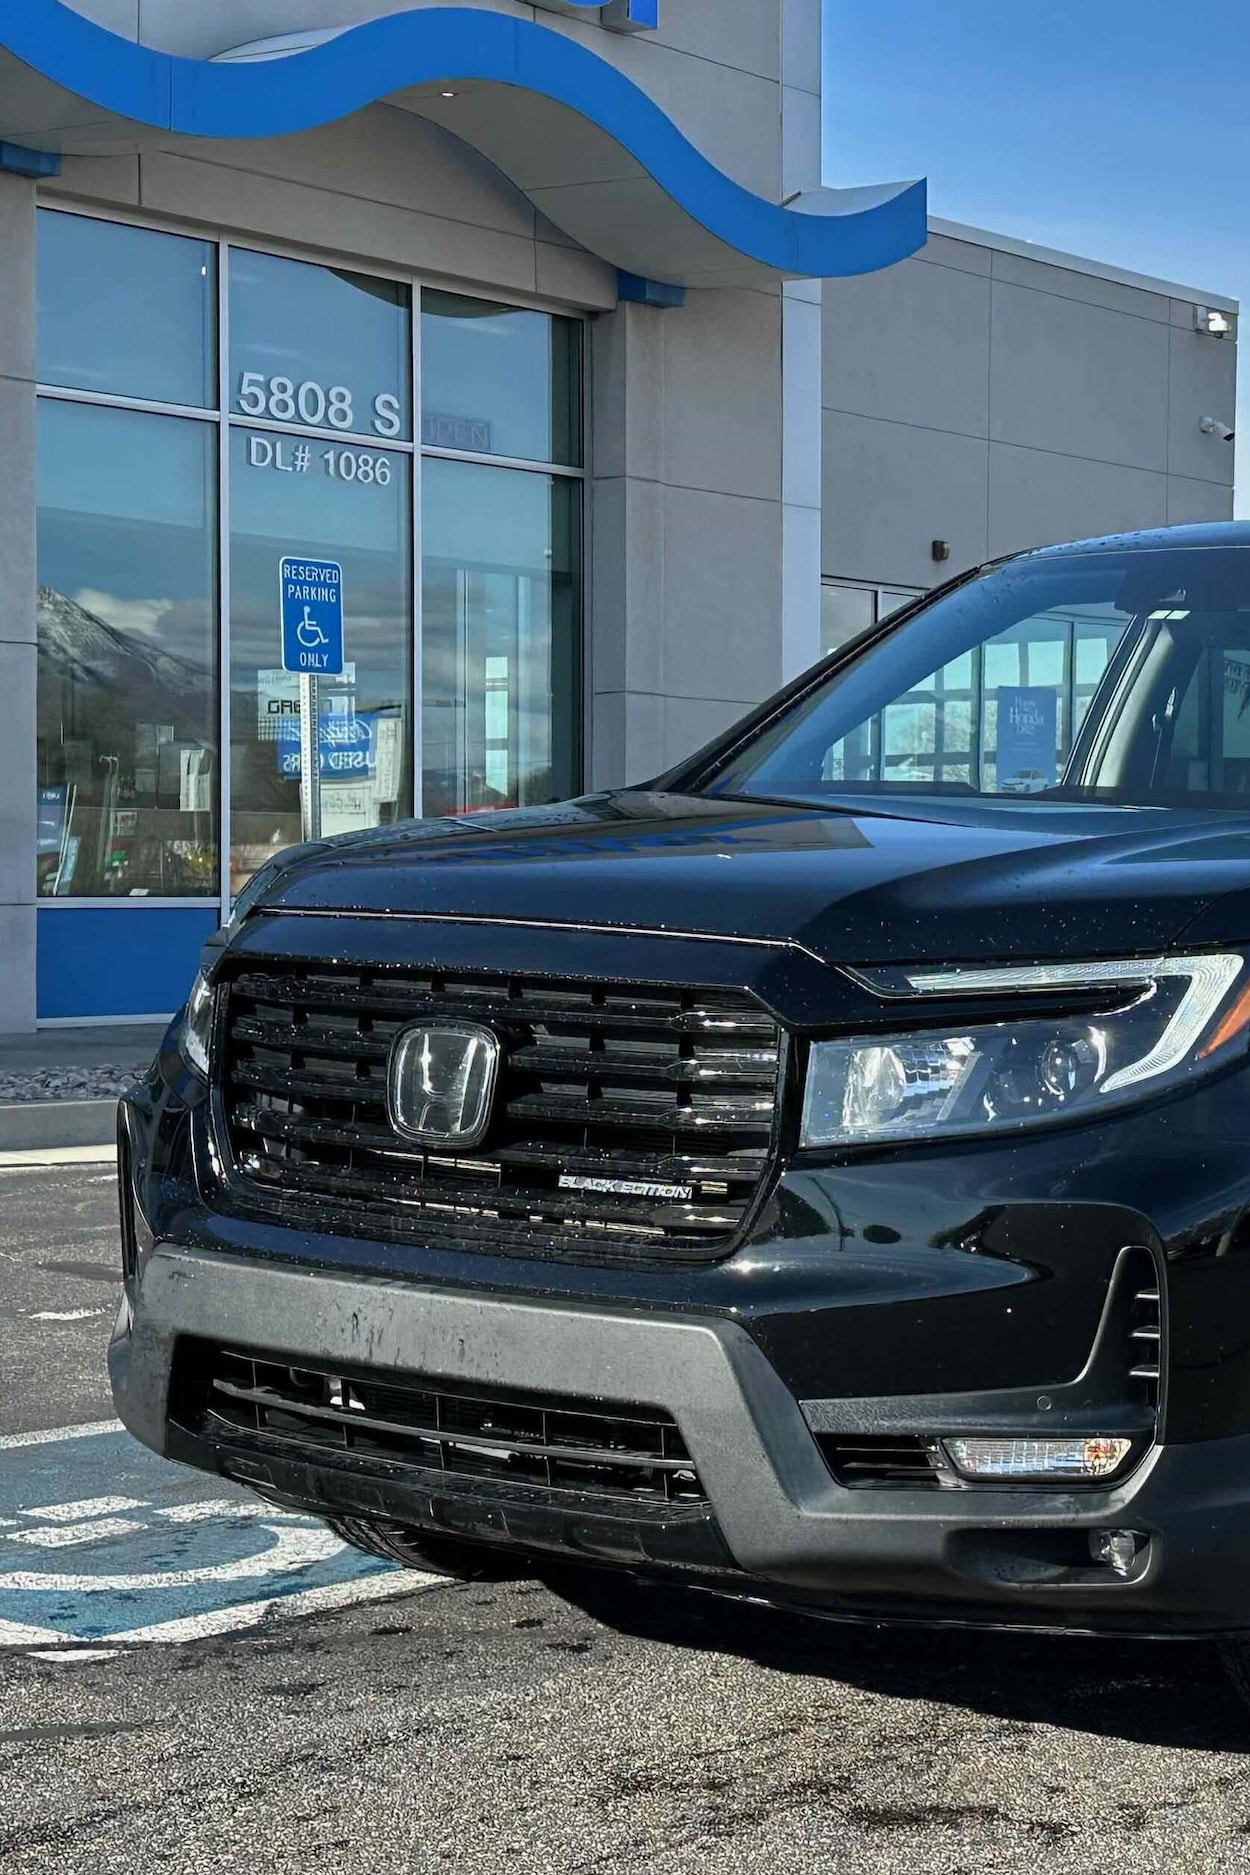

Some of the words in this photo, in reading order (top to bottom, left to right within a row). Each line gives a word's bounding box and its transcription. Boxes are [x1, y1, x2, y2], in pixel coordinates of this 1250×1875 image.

[238, 371, 354, 429] 5808
[374, 393, 401, 437] S
[249, 436, 311, 473] DL#
[323, 449, 391, 486] 1086
[284, 564, 339, 584] RESERVED
[287, 584, 337, 603] PARKING
[299, 652, 329, 668] ONLY
[558, 1174, 617, 1192] BLACK
[621, 1181, 693, 1199] EDITION
